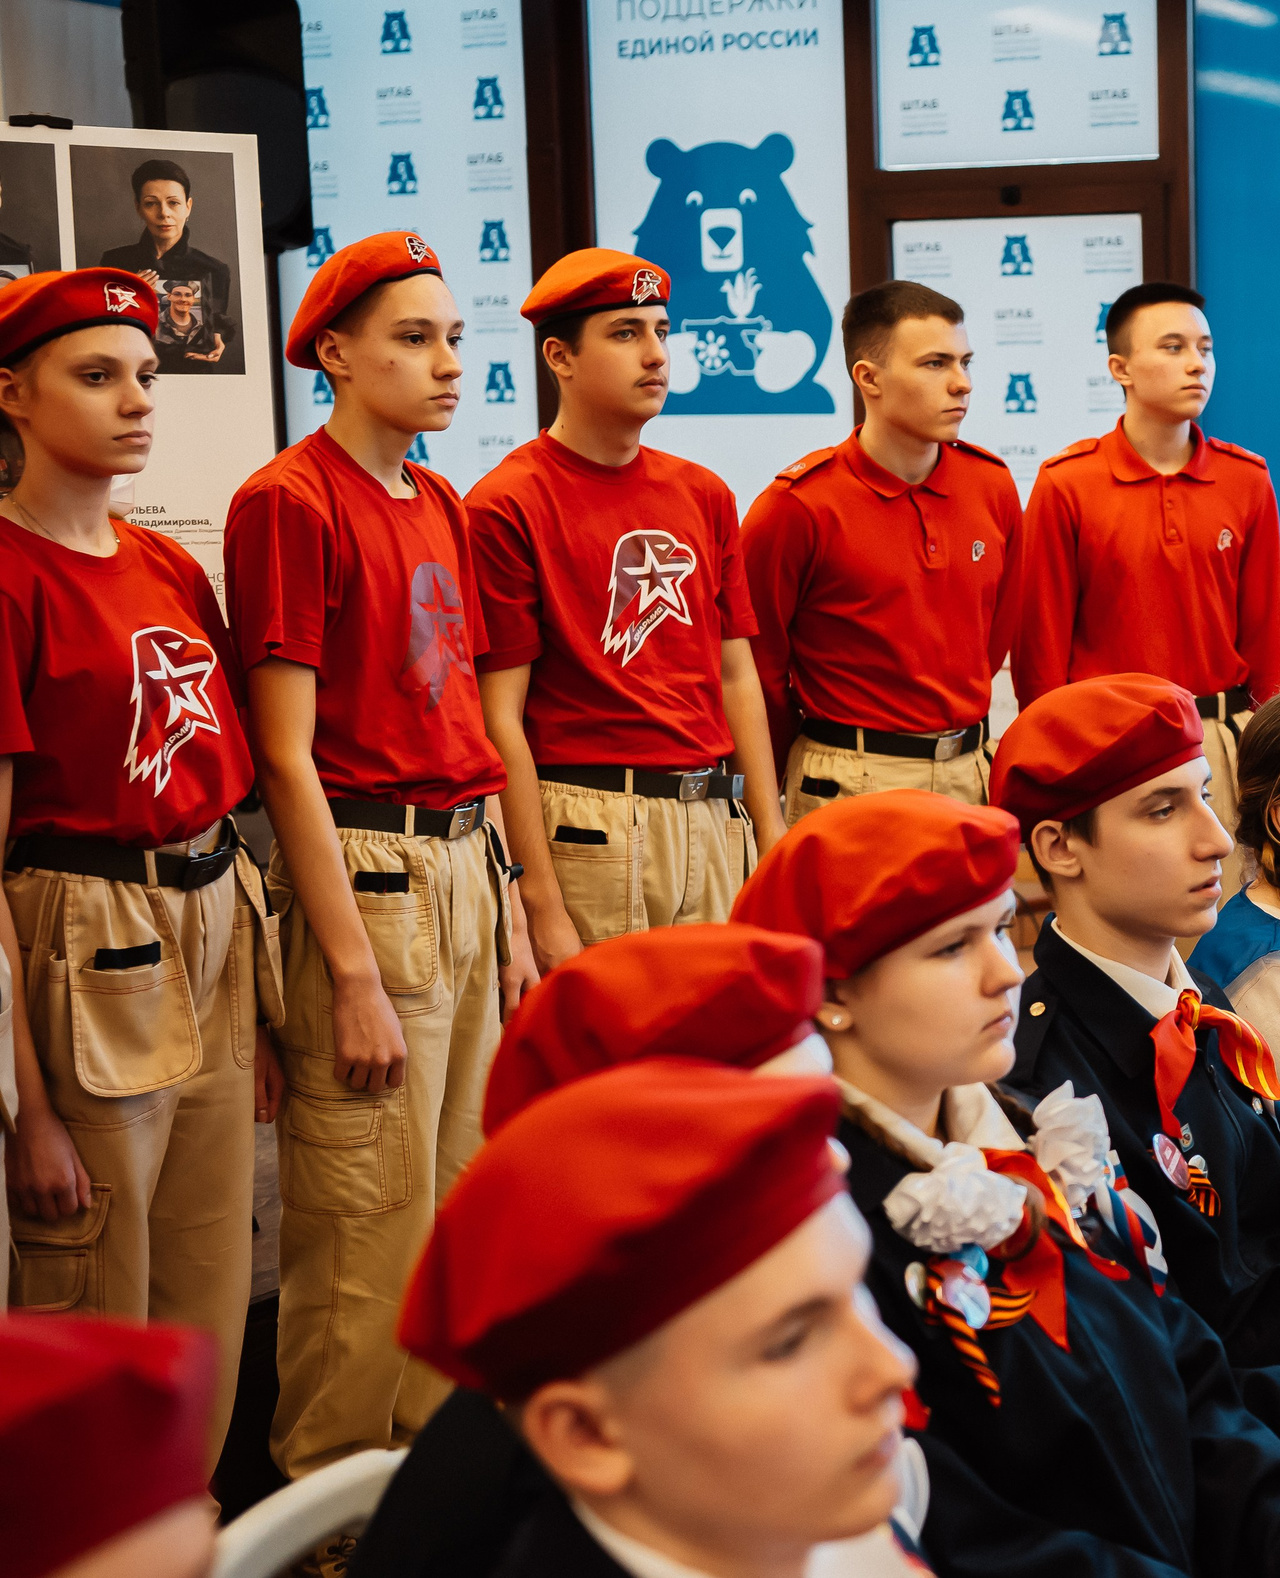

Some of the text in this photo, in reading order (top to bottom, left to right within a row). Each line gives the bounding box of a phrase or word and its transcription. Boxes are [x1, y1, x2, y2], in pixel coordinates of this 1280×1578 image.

[617, 28, 819, 60] ЕДИНОЙ РОССИИ
[130, 506, 166, 514] ЛЬЕВА
